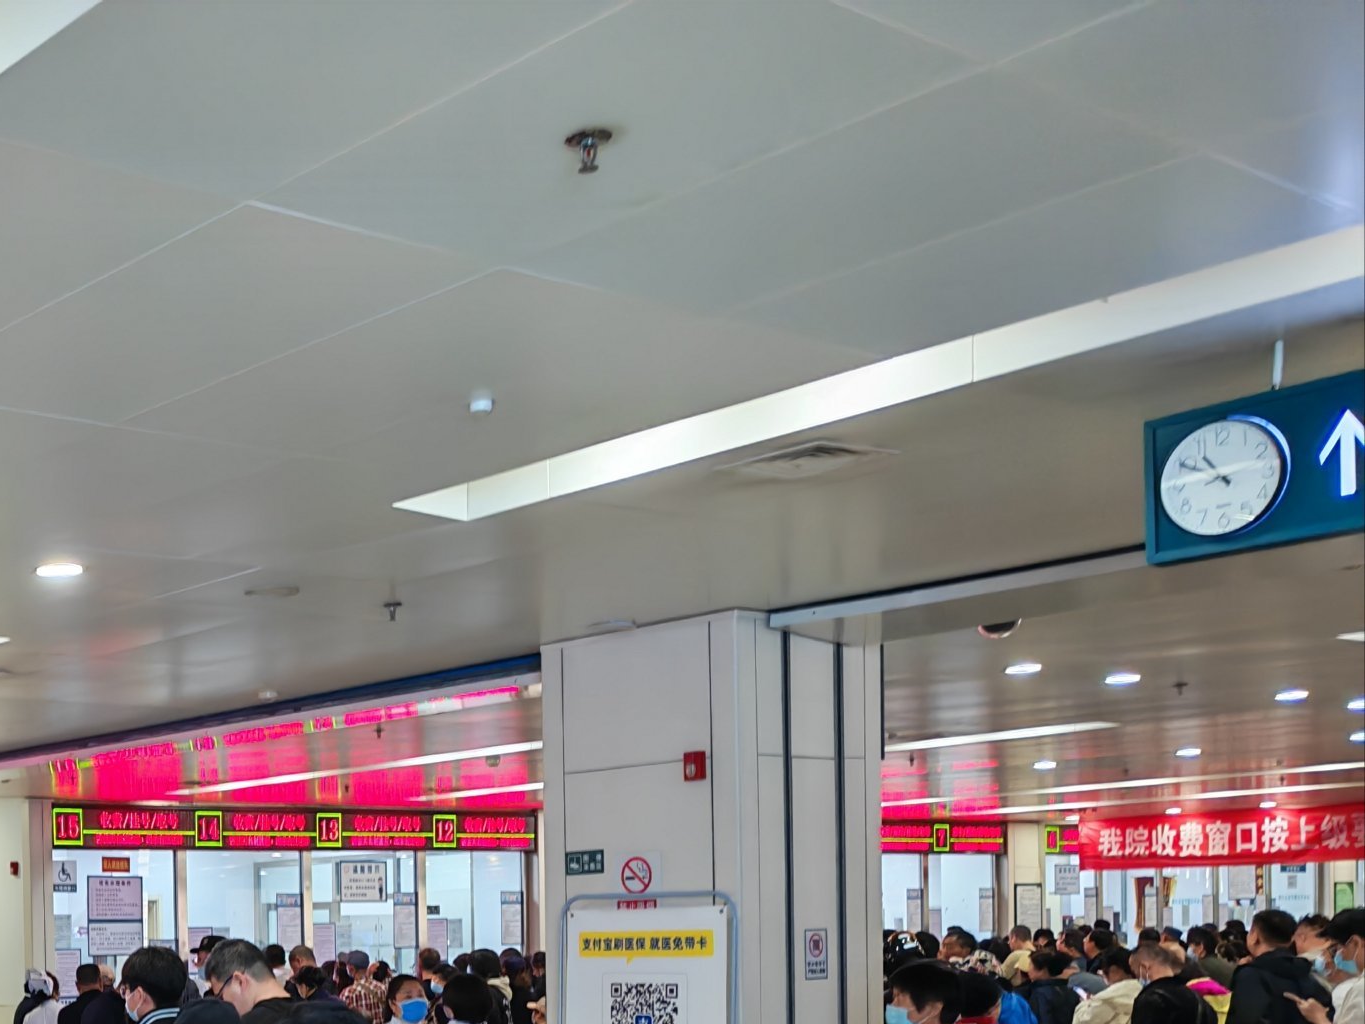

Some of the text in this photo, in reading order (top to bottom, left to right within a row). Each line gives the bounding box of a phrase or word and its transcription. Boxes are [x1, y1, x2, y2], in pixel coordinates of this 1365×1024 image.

[58, 814, 79, 839] 15
[199, 817, 220, 841] 14
[320, 819, 339, 841] 13
[437, 820, 454, 842] 12
[582, 935, 707, 951] 支付宝刷医保 就医免带卡
